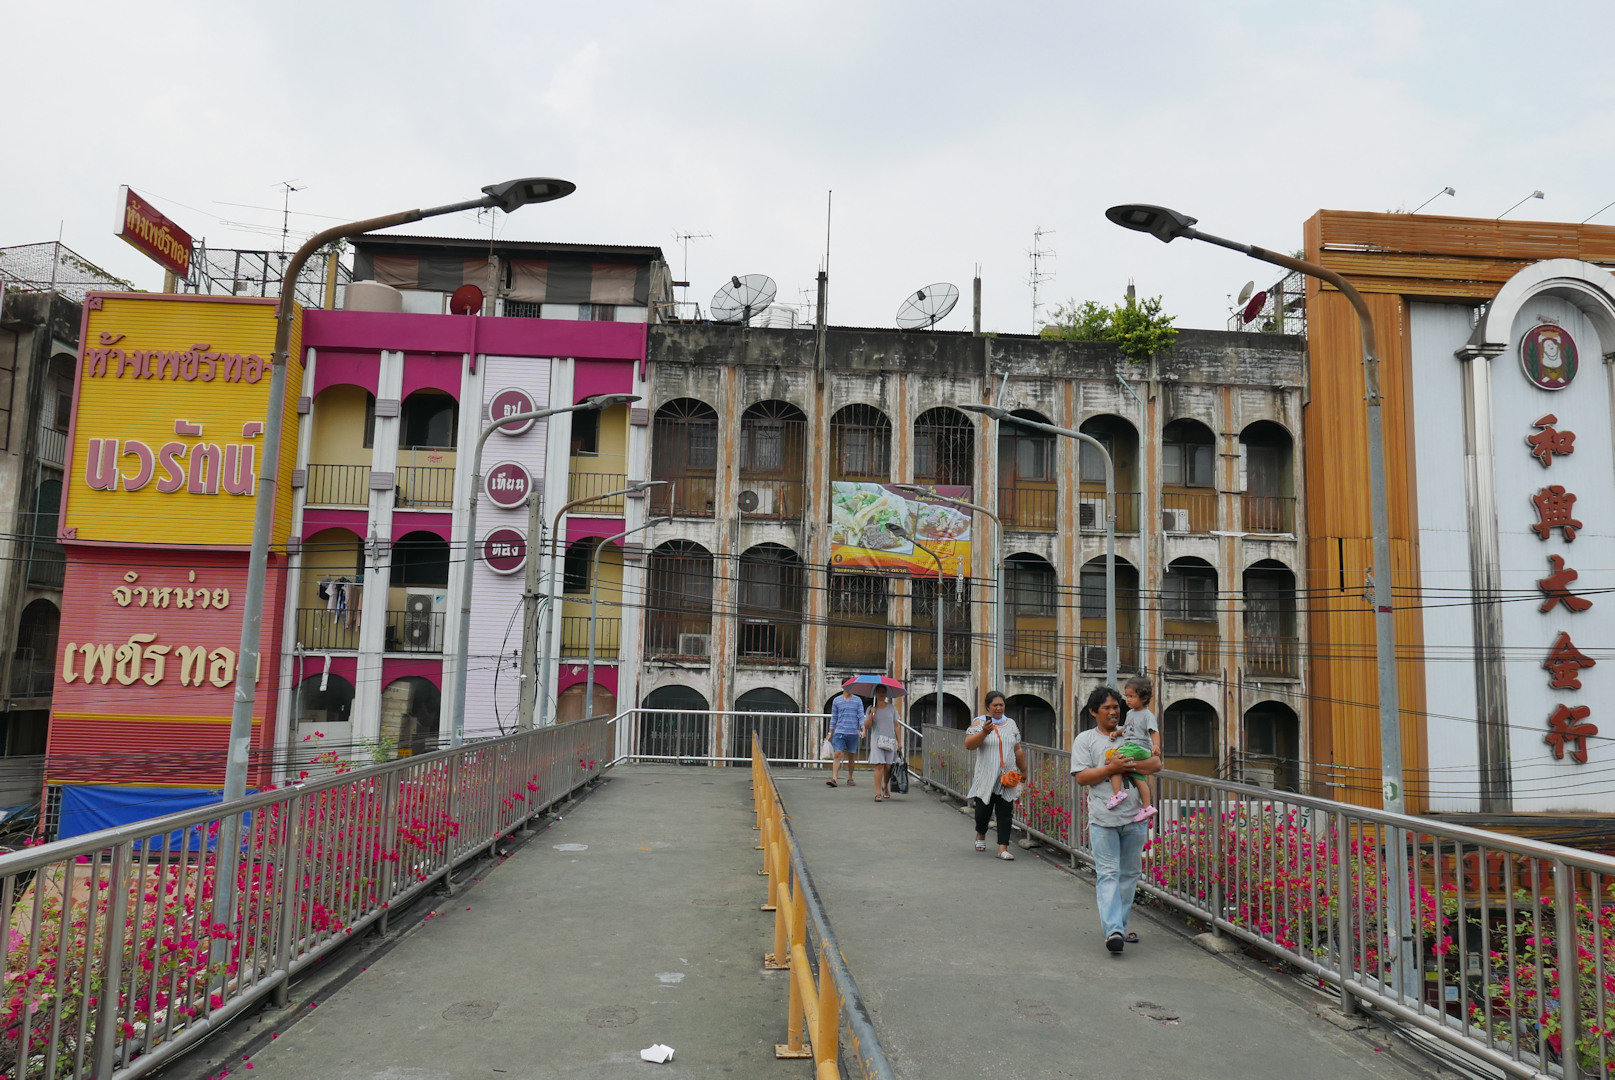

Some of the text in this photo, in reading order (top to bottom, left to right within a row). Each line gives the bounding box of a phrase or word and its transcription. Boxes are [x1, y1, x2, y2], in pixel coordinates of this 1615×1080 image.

[85, 331, 273, 384] ห้างเพชรทอ
[85, 419, 264, 496] นวรัตน์
[112, 570, 230, 610] จำหน่าย
[1525, 413, 1599, 764] 和興大金行
[62, 633, 262, 688] เพชรทอ
